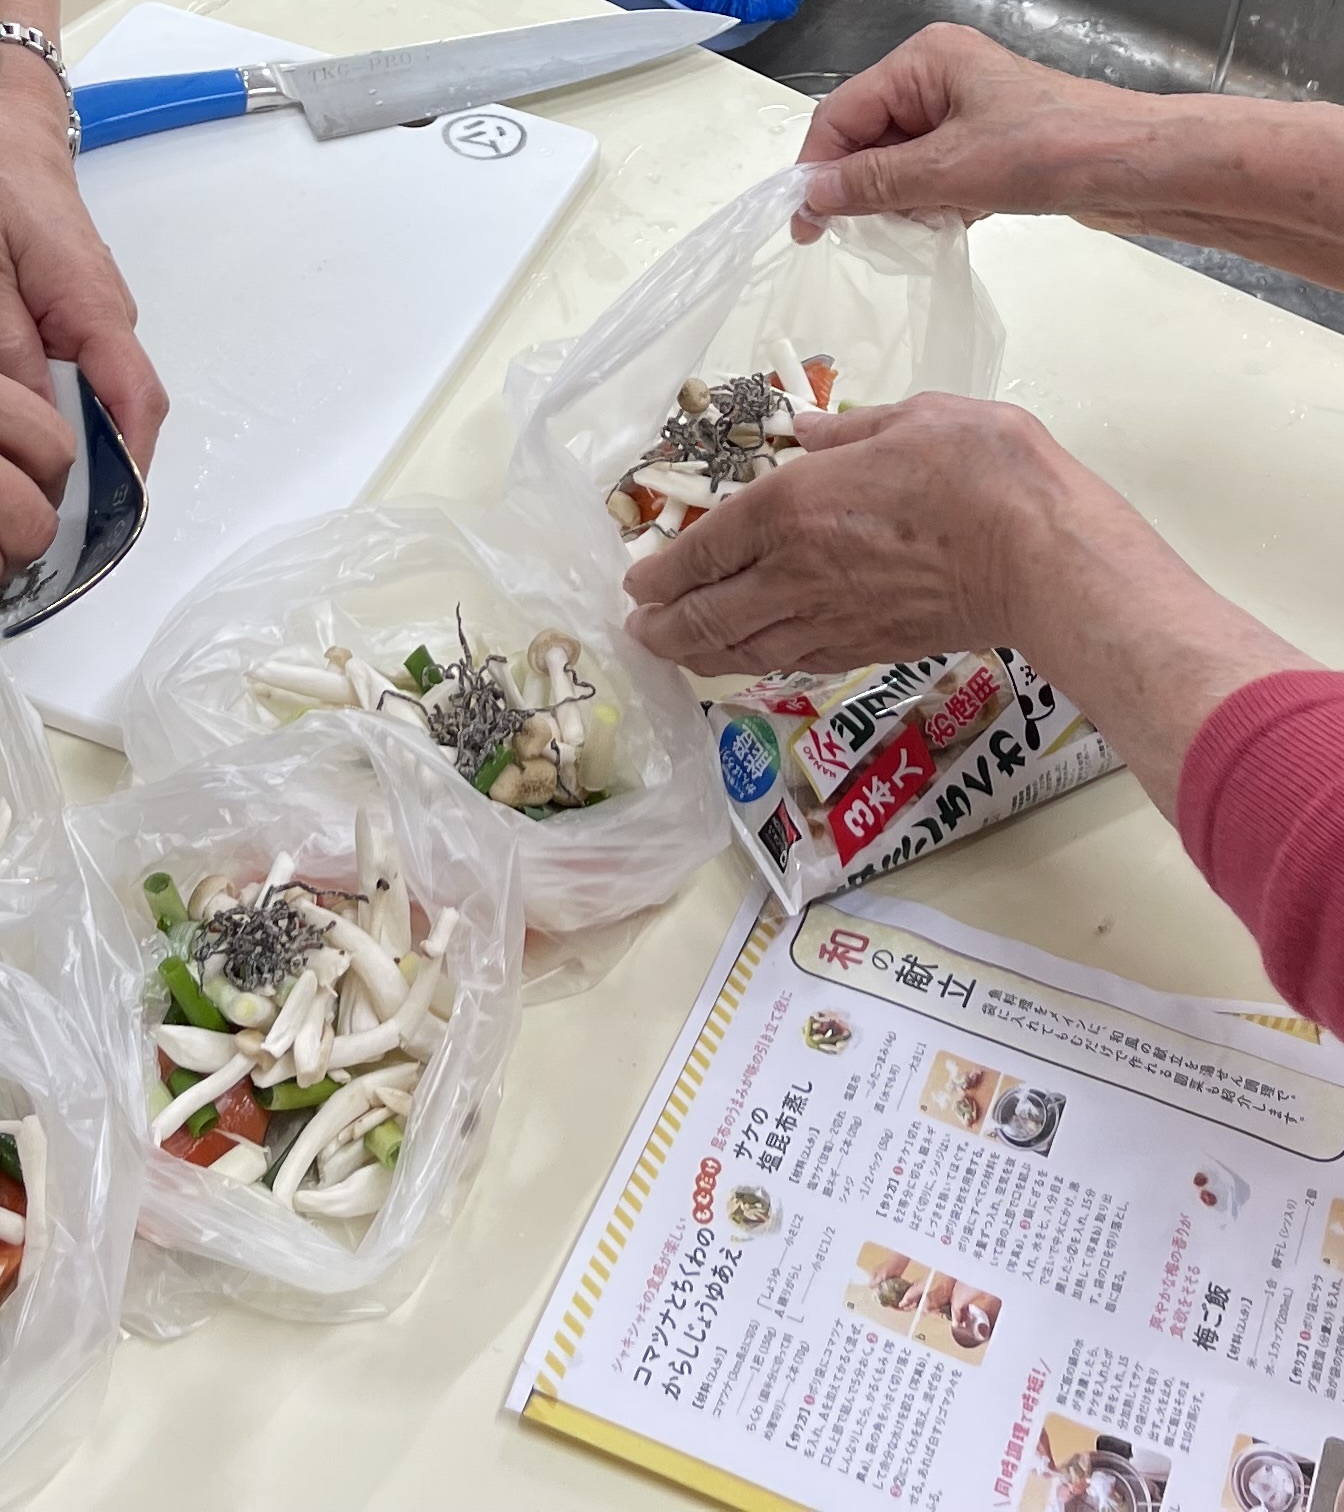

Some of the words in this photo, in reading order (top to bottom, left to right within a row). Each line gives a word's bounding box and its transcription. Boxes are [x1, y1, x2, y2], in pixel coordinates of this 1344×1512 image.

[307, 51, 413, 83] TKG-PRO
[925, 666, 1001, 748] お徳用
[732, 723, 773, 780] 能登
[803, 745, 838, 780] HANAO
[843, 748, 924, 838] 3本入
[838, 729, 1026, 890] タミンちくわ
[815, 921, 978, 1008] 和の献立
[710, 988, 793, 1151] 昆布のうまみが味の引き立て役に
[731, 1104, 771, 1163] サケの
[754, 1074, 815, 1175] 塩昆布蒸し
[609, 1215, 690, 1374] シャキシャキの食感が楽しい
[629, 1225, 718, 1387] コマツナとちくわの
[1148, 1212, 1195, 1332] 爽やかな梅の香りが
[1168, 1264, 1203, 1339] 食欲をそそる
[1192, 1281, 1231, 1351] 梅ご飯
[658, 1242, 743, 1400] からしじょうゆあえ
